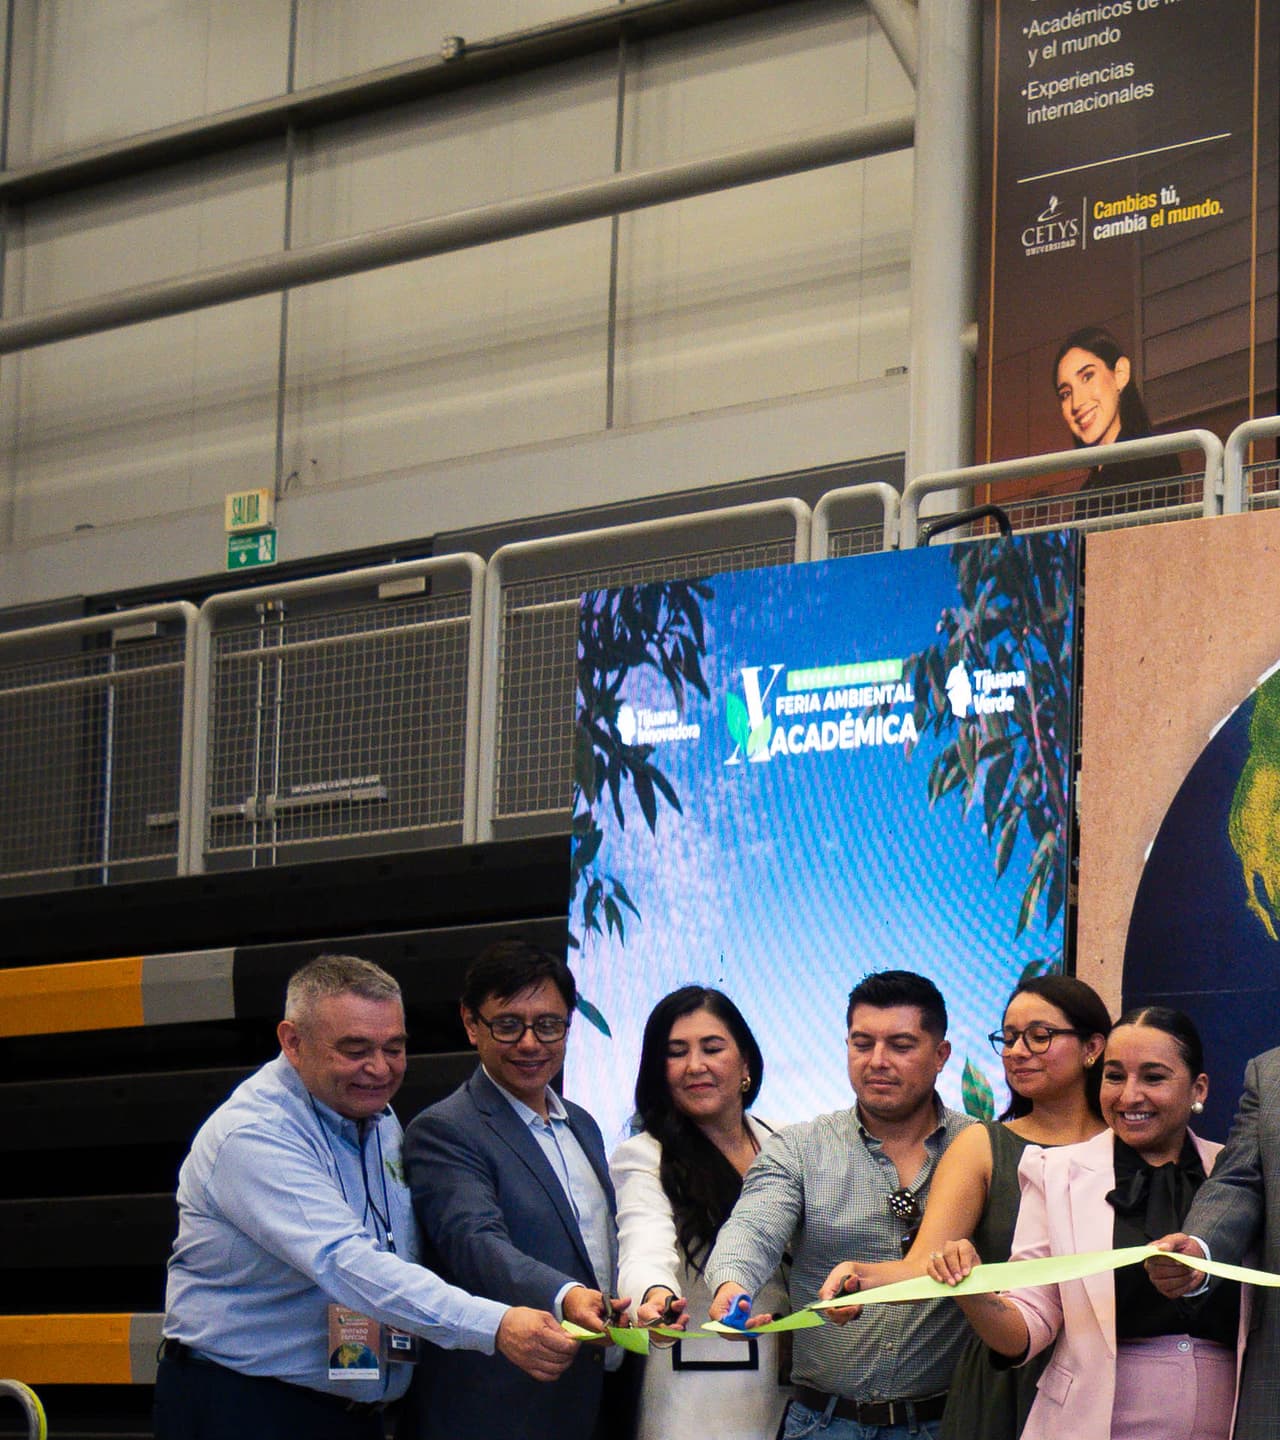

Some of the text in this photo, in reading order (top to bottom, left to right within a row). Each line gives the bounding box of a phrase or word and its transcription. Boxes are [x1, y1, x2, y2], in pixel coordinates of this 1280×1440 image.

[1027, 1, 1132, 38] Académicos
[1027, 27, 1121, 67] y el mundo
[1027, 61, 1135, 100] Experiencias
[1026, 82, 1155, 125] internacionales
[1093, 198, 1224, 240] cambia el mundo.
[1094, 185, 1180, 219] Cambias tú,
[1021, 218, 1079, 247] CETYS
[231, 494, 260, 526] SALIDA
[775, 682, 915, 716] FERIA AMBIENTAL
[973, 669, 1025, 695] Tijuana
[973, 689, 1015, 714] Verde
[637, 721, 700, 744] Innovadora
[770, 711, 918, 757] ACADÉMICA
